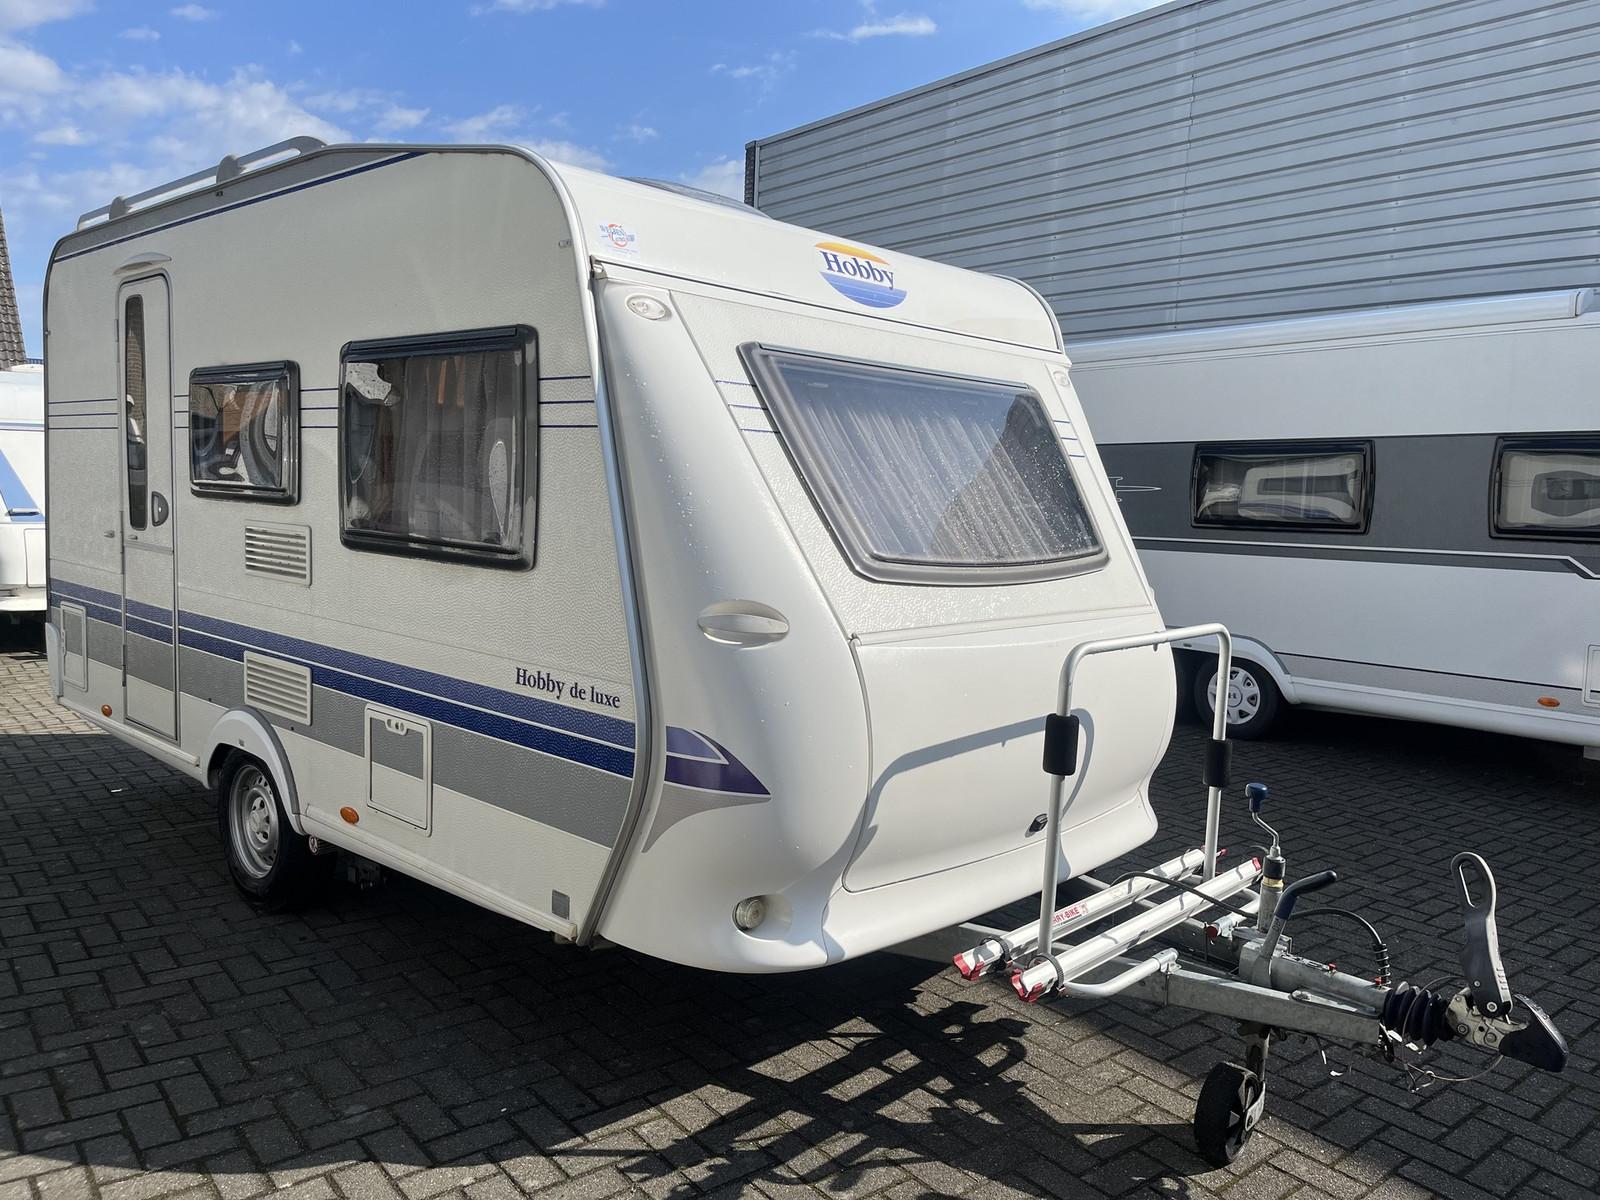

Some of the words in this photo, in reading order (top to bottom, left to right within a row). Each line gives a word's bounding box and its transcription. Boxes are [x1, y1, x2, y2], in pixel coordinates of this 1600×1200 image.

[819, 250, 894, 290] Hobby
[516, 667, 565, 699] Hobby
[570, 682, 586, 700] de
[590, 686, 620, 708] luxe
